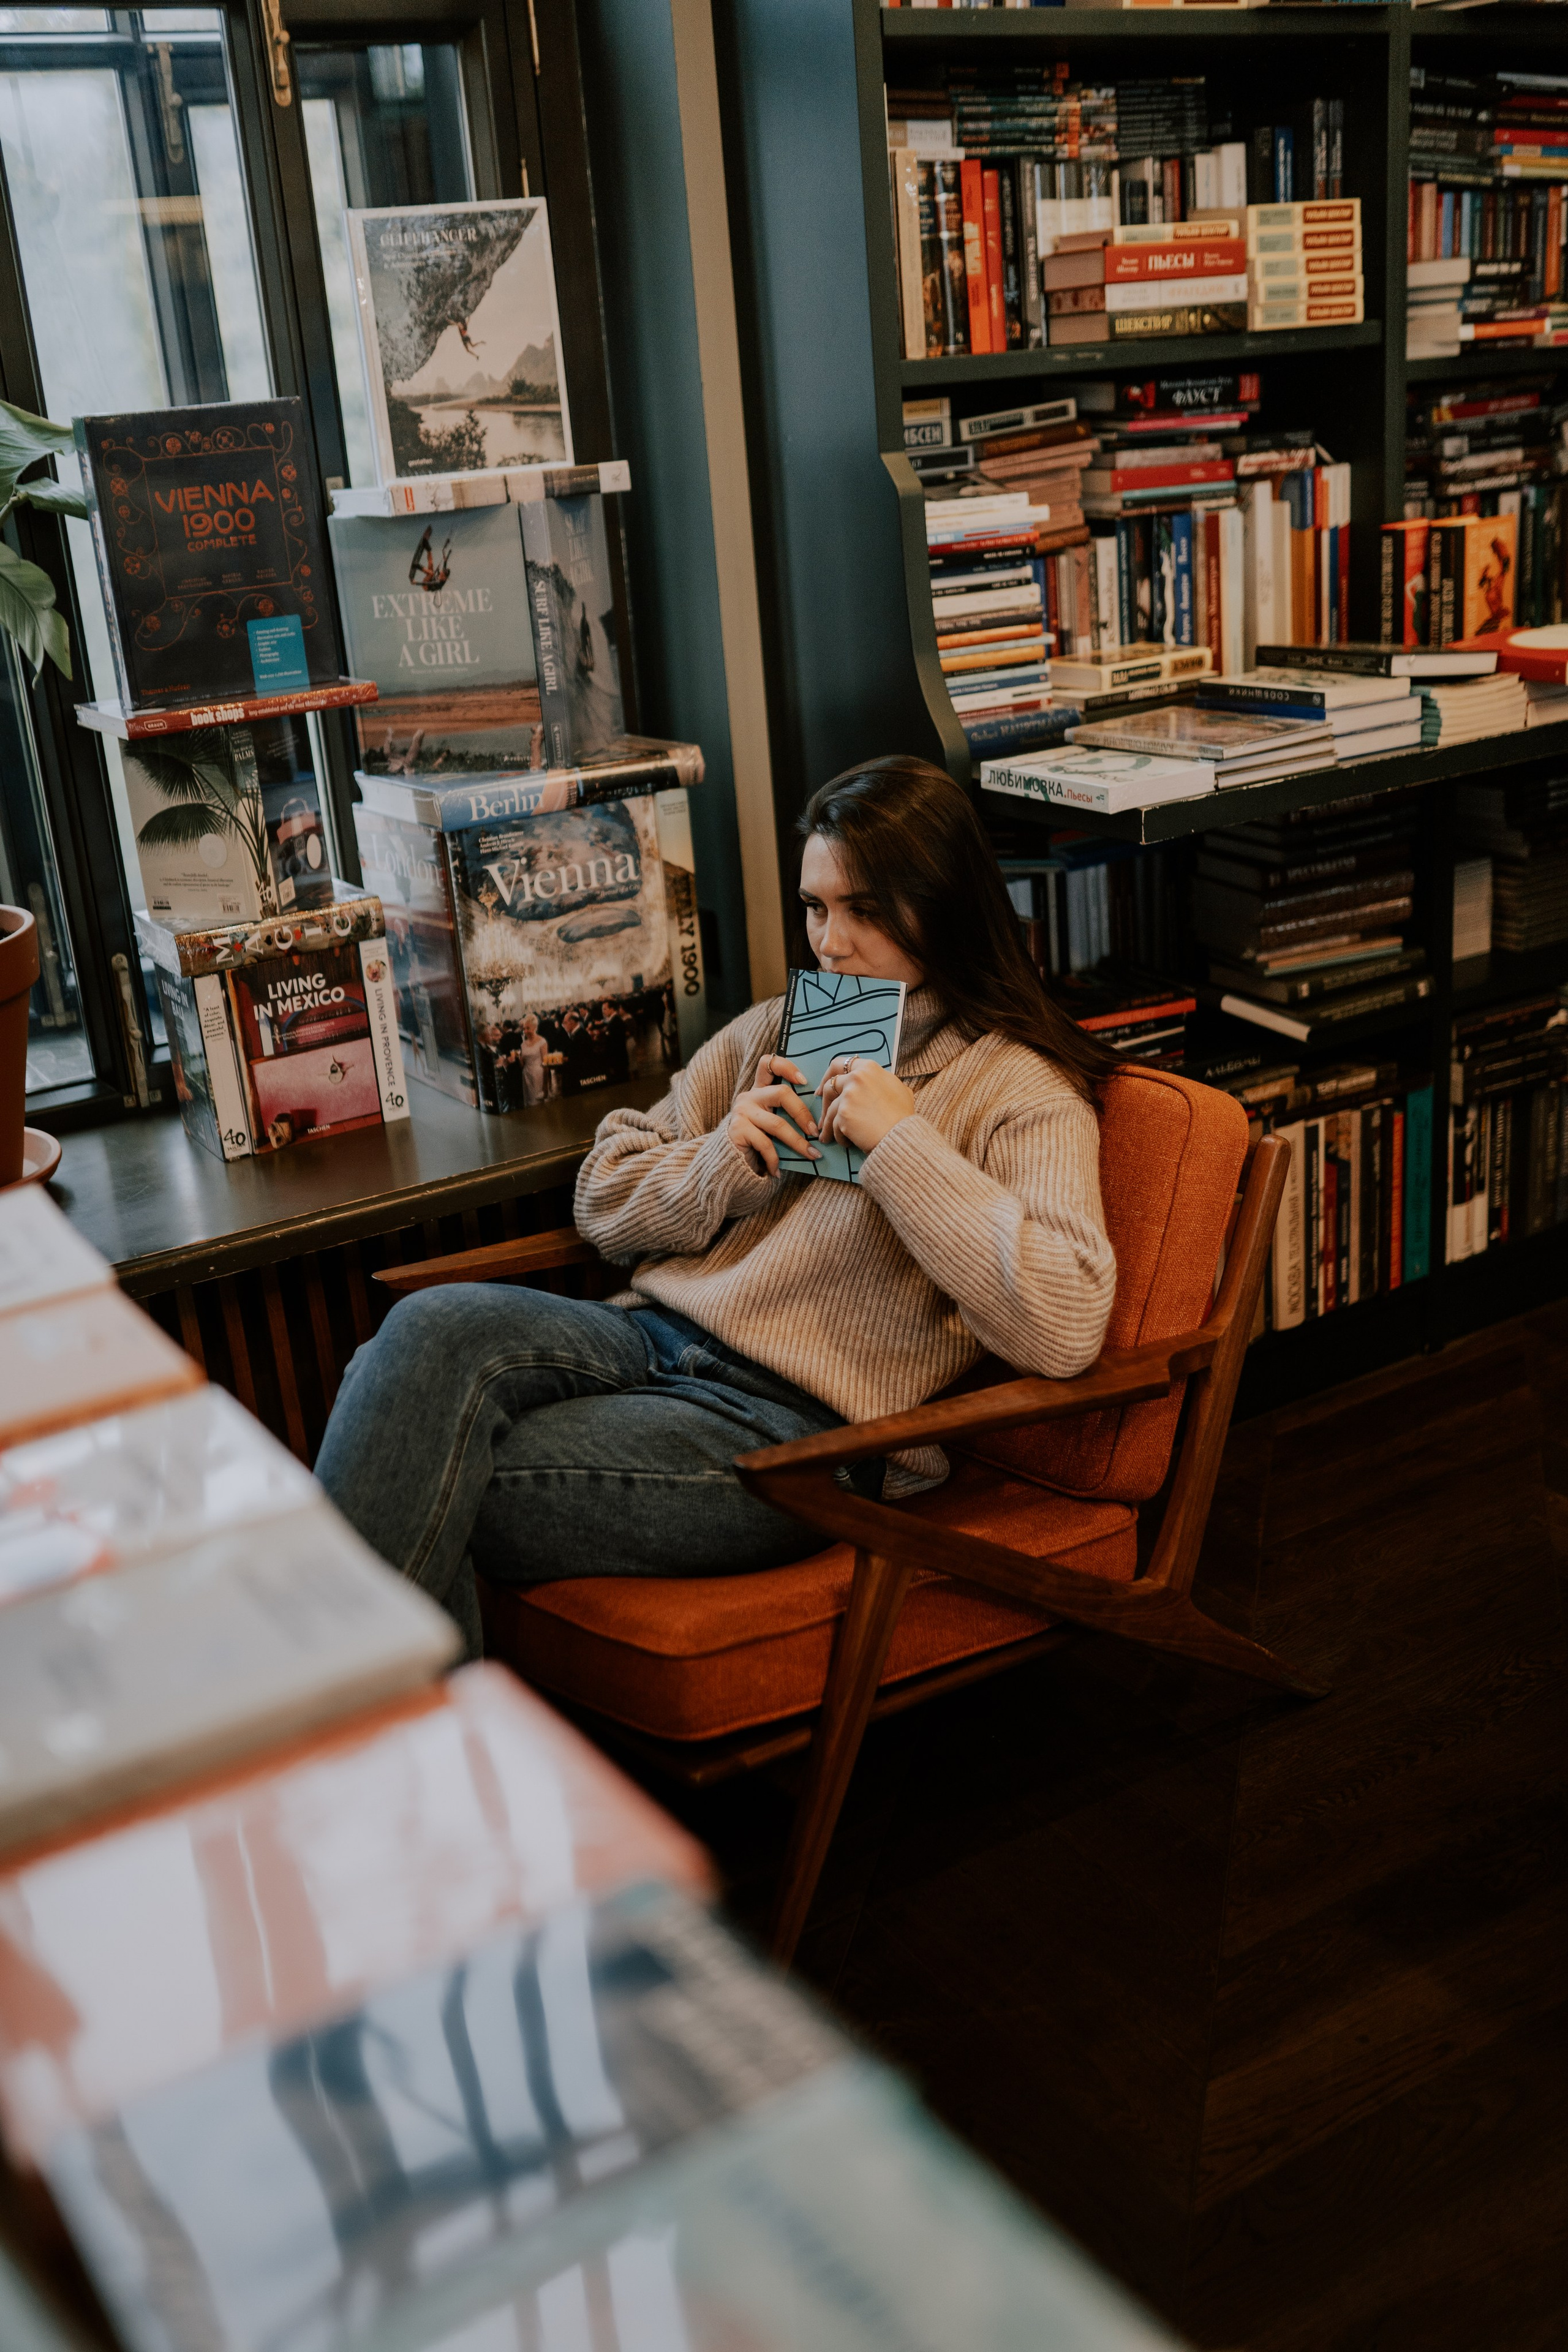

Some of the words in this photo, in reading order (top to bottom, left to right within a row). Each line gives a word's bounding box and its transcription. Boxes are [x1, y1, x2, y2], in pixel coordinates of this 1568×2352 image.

[1148, 252, 1195, 272] ПЬЕСЫ
[1115, 314, 1172, 334] ШЕКСПИР
[1172, 386, 1223, 406] ФАУСТ
[154, 479, 275, 513] VIENNA
[183, 507, 255, 538] 1900
[187, 533, 257, 552] COMPLETE
[371, 587, 493, 619] EXTREME
[534, 580, 548, 614] SURF
[405, 616, 464, 643] LIKE
[538, 617, 552, 650] LIKE
[399, 644, 415, 668] A
[419, 640, 480, 667] GIRL
[543, 652, 554, 663] A
[543, 662, 558, 696] GIRL
[1228, 687, 1290, 702] СООБЩНИКИ
[190, 709, 215, 727] book
[215, 707, 245, 723] shops
[233, 749, 255, 762] PALMS
[469, 785, 544, 821] Berlin
[1067, 789, 1093, 803] Пьесы
[369, 834, 443, 888] London
[258, 882, 273, 902] 40
[482, 853, 641, 907] Vienna
[212, 914, 352, 965] MAGIC
[680, 943, 700, 997] 1900
[161, 979, 181, 1003] LIVING
[268, 973, 326, 1000] LIVING
[253, 1002, 273, 1021] IN
[277, 986, 345, 1016] MEXICO
[375, 987, 386, 1021] LIVING
[380, 1022, 388, 1034] IN
[382, 1035, 396, 1087] PROVENCE
[579, 1074, 607, 1087] TASCHEN
[385, 1091, 404, 1107] 40
[223, 1128, 246, 1145] 40
[307, 1125, 331, 1134] TASCHEN
